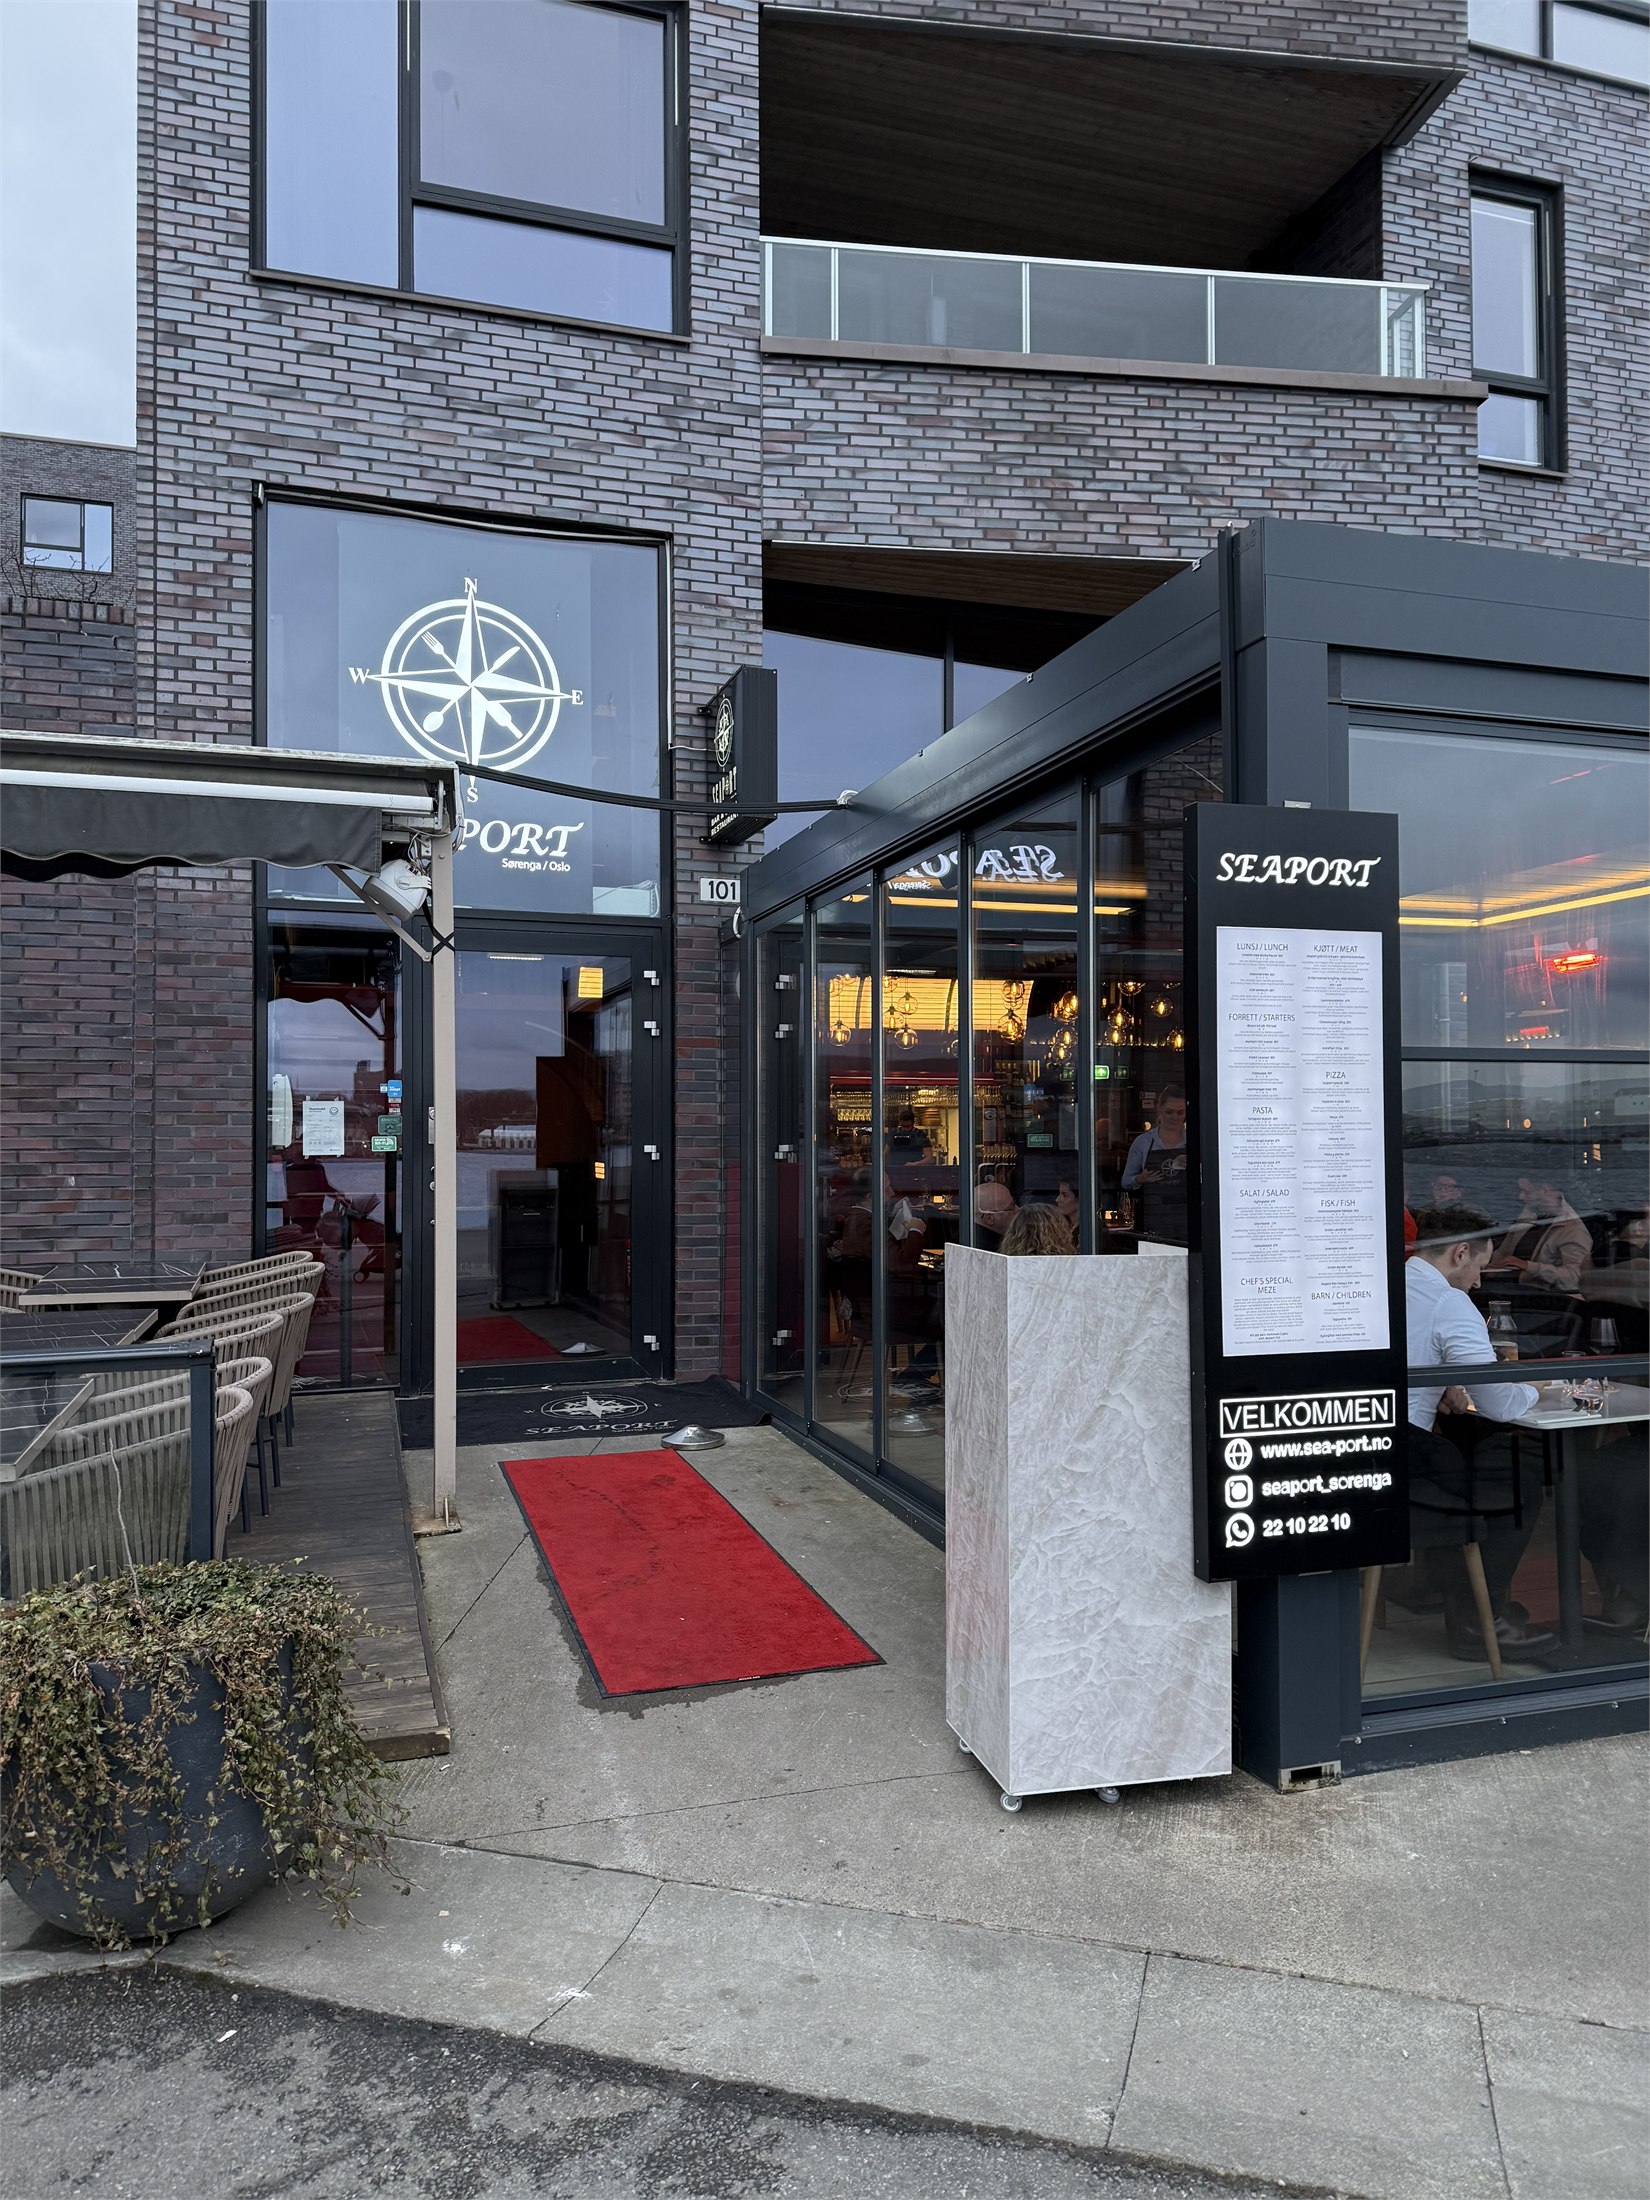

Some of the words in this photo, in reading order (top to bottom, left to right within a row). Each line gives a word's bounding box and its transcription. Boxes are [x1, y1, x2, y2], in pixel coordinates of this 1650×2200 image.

[464, 577, 478, 593] N
[348, 668, 371, 685] W
[571, 690, 584, 706] E
[466, 787, 479, 803] S
[458, 818, 584, 857] PORT
[501, 858, 542, 872] Sørenga
[548, 861, 571, 872] Oslo
[1216, 853, 1382, 887] SEAPORT
[708, 880, 736, 900] 101
[1236, 943, 1259, 951] LUNSJ
[1264, 943, 1289, 951] LUNCH
[1340, 945, 1358, 953] MEAT
[1228, 1013, 1258, 1021] FORRETT
[1325, 1071, 1346, 1079] PIZZA
[1252, 1106, 1273, 1114] PASTA
[1240, 1189, 1261, 1197] SALAT
[1266, 1189, 1290, 1197] SALAD
[1320, 1199, 1335, 1207] FISK
[1340, 1199, 1356, 1207] FISH
[1265, 1276, 1293, 1285] SPECIAL
[1257, 1286, 1277, 1294] MEZE
[1311, 1292, 1331, 1300] BARN
[1336, 1291, 1372, 1299] CHILDREN
[1223, 1397, 1389, 1431] VELKOMMEN
[524, 1420, 678, 1435] SEAPORT
[1260, 1435, 1393, 1459] www.sea-port.no
[1261, 1472, 1393, 1497] seaport_sorenga
[1262, 1518, 1284, 1537] 22
[1286, 1517, 1306, 1535] 10
[1308, 1515, 1329, 1533] 22
[1331, 1512, 1351, 1530] 10
